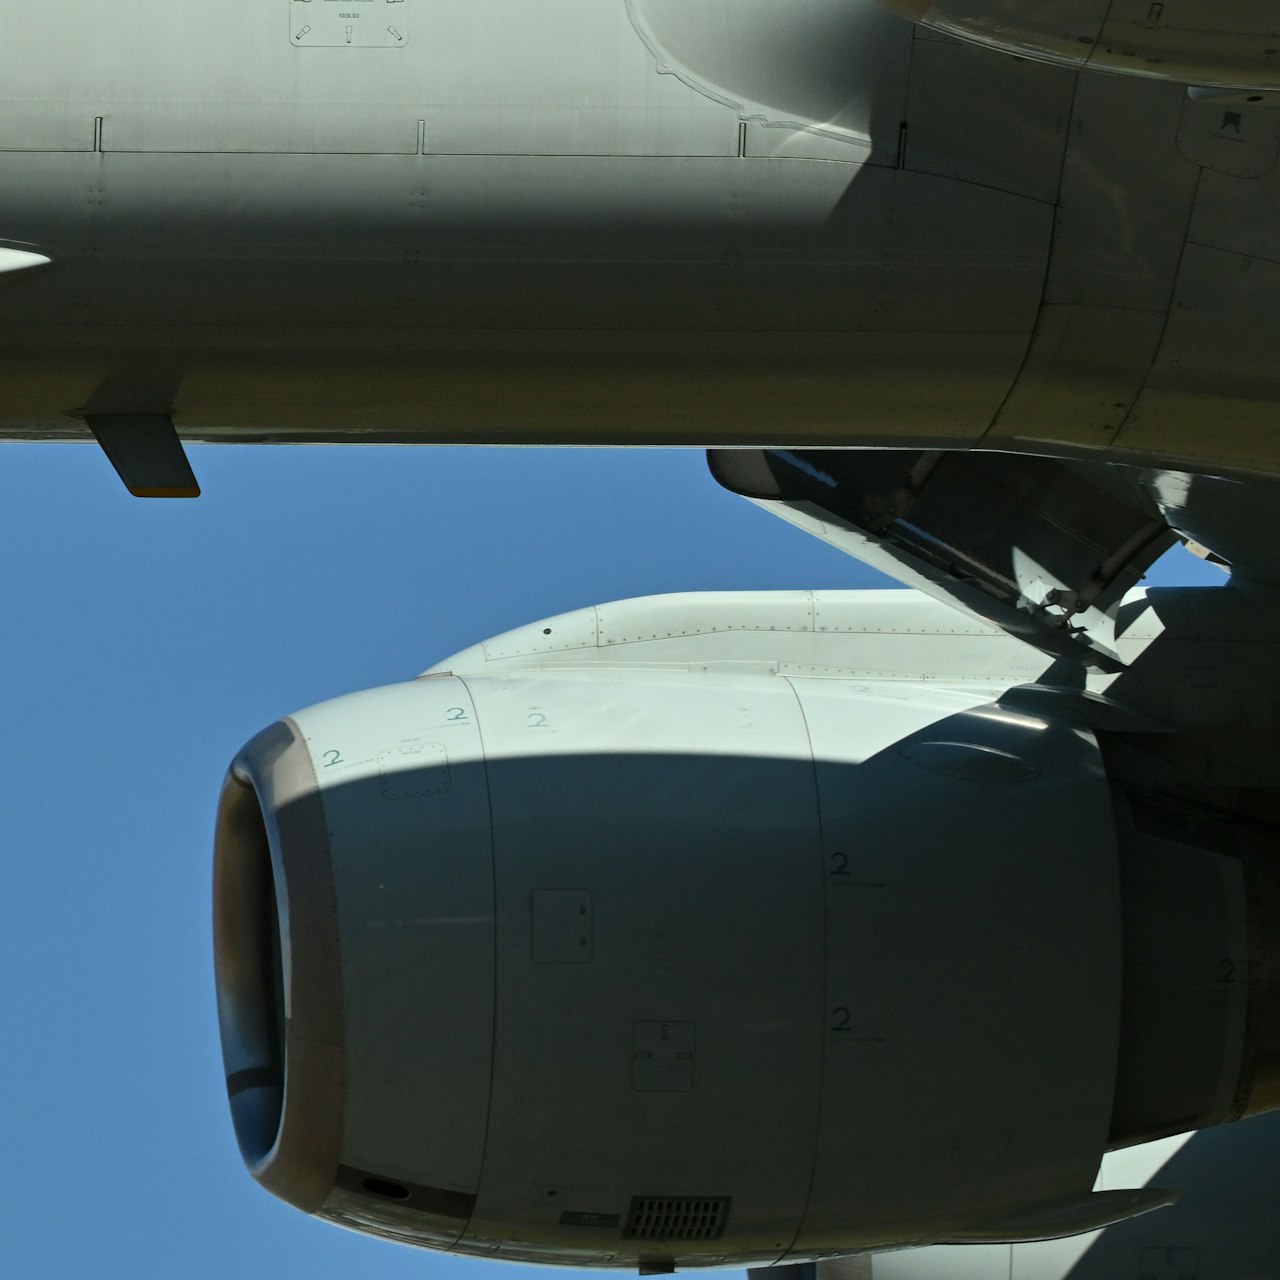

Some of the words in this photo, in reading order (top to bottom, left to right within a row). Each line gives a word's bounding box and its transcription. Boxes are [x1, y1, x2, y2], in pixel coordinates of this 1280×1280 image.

[446, 707, 468, 721] 2
[528, 713, 549, 727] 2
[323, 749, 344, 767] 2
[830, 852, 851, 875] 2
[1216, 958, 1236, 983] 2
[831, 1006, 851, 1031] 2
